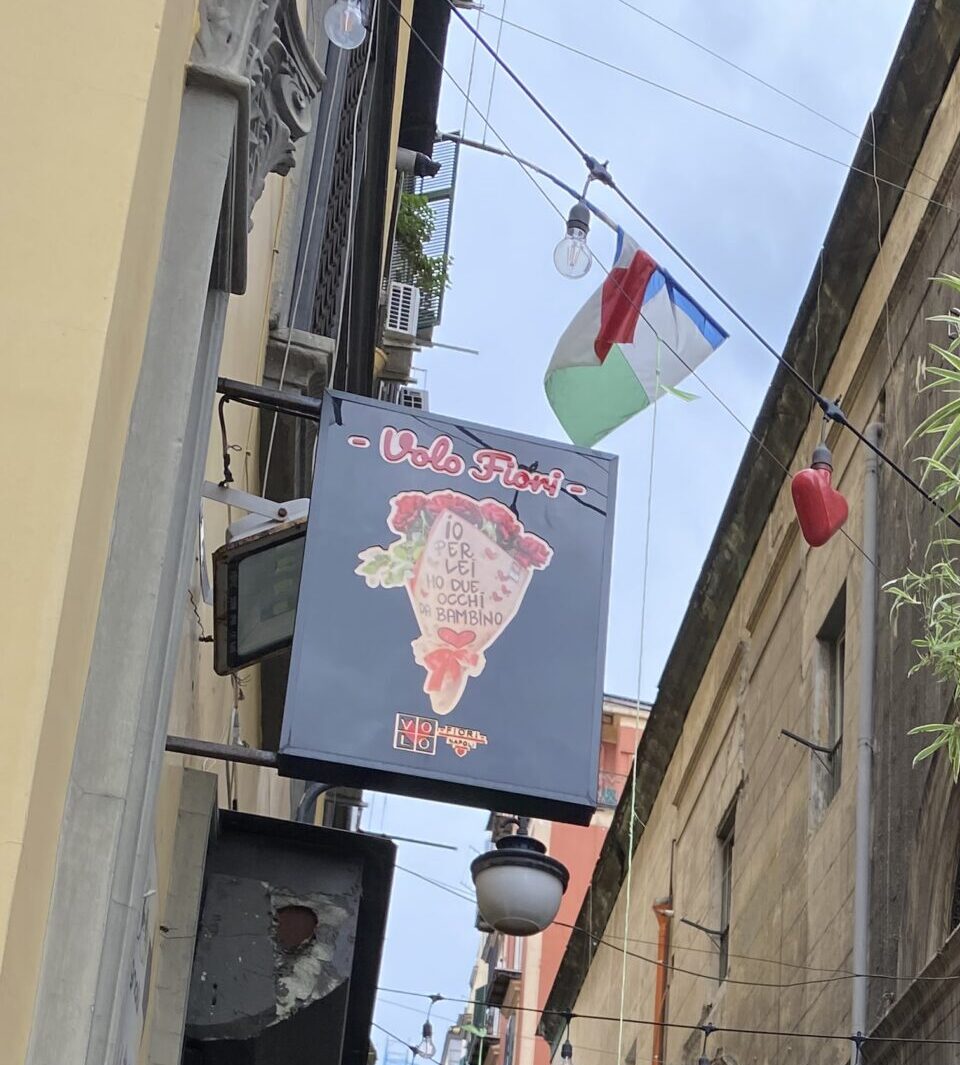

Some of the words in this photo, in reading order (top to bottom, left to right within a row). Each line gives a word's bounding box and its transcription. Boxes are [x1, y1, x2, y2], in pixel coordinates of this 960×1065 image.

[381, 428, 463, 474] Volo
[470, 450, 563, 496] Fiori
[434, 540, 474, 559] PER
[426, 574, 444, 589] HO
[451, 579, 480, 593] DUE
